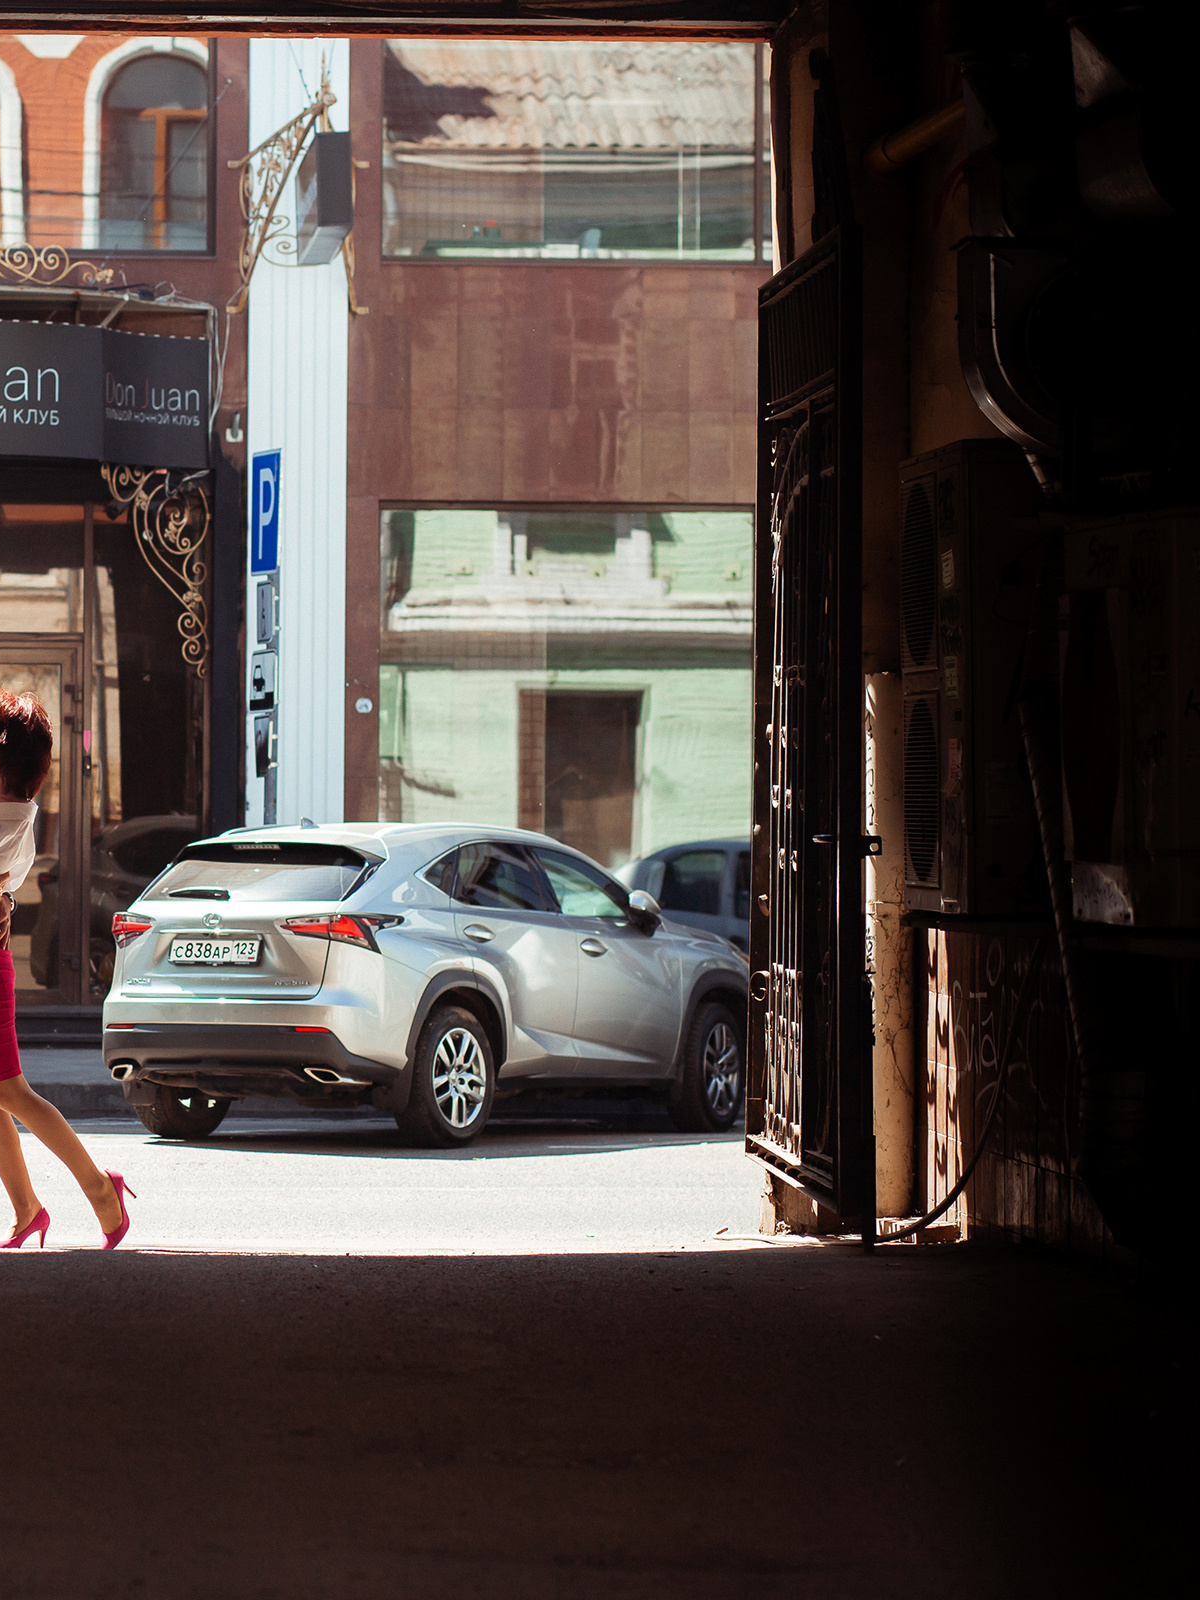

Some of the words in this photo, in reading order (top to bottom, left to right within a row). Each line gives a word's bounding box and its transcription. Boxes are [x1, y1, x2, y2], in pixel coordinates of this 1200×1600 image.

[106, 372, 135, 407] Don
[141, 378, 200, 411] Juan
[13, 408, 60, 426] КЛУБ
[172, 414, 200, 427] КЛУБ
[234, 943, 255, 955] 123
